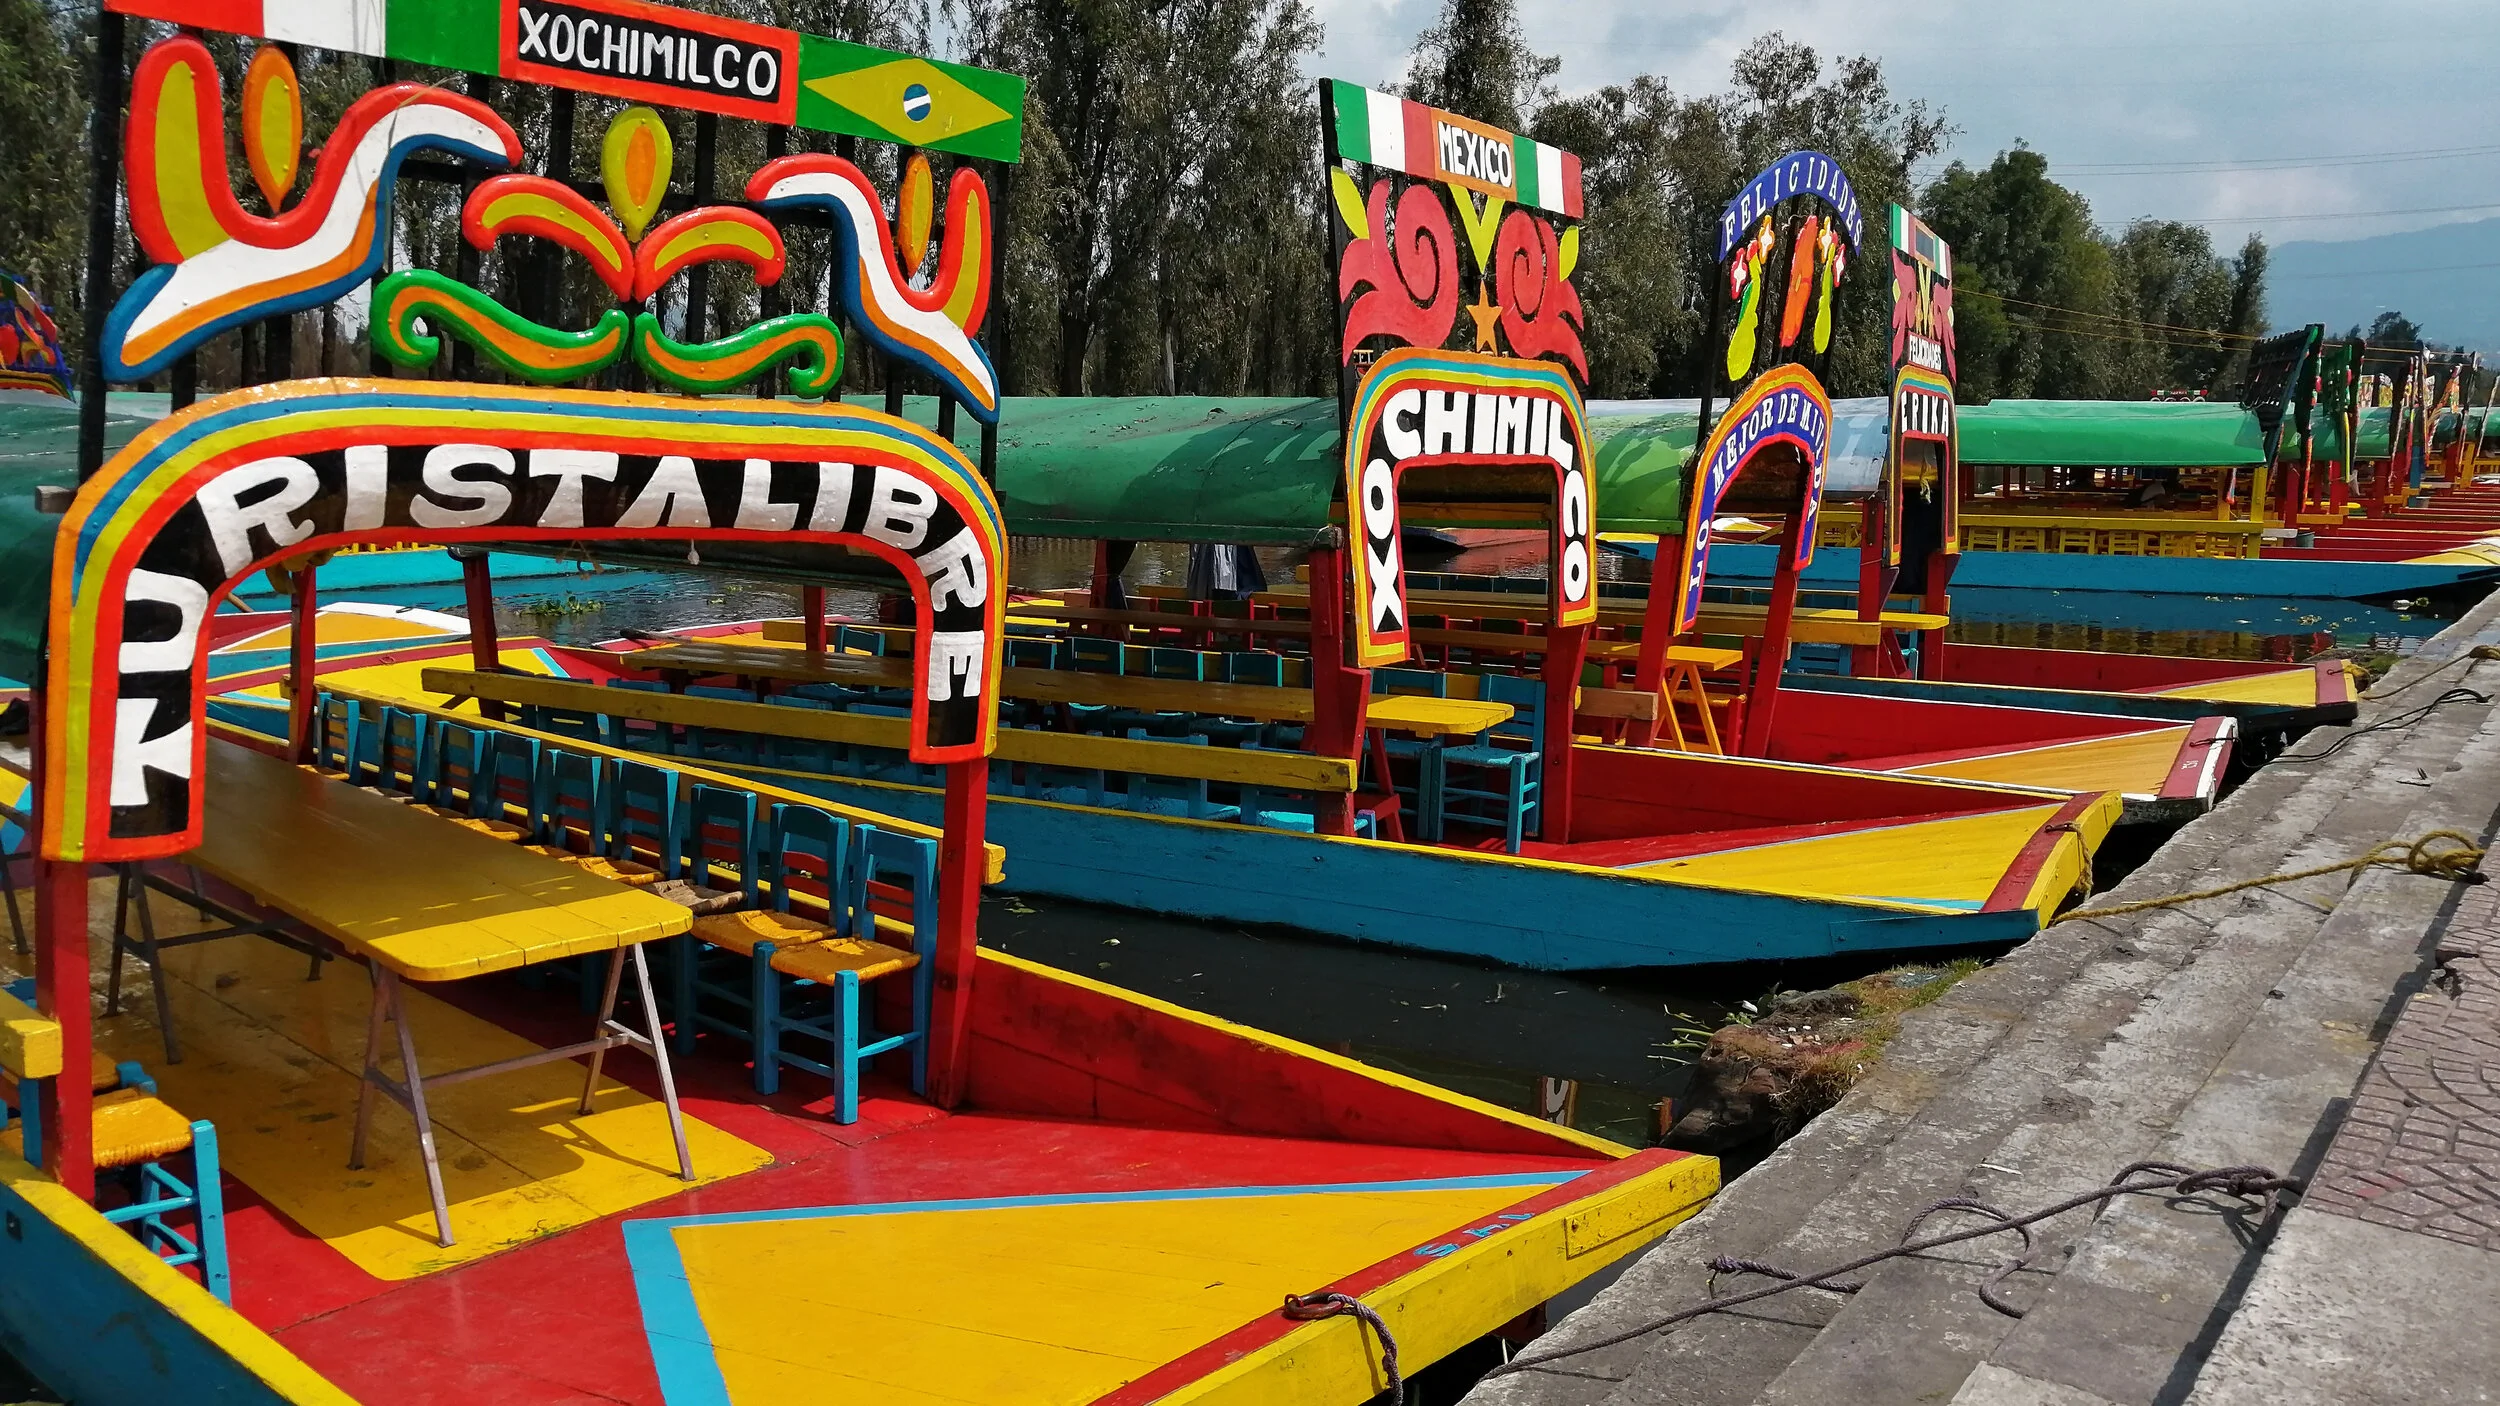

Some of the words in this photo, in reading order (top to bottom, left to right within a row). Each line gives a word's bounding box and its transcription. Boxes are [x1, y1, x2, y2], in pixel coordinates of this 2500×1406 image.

[519, 7, 778, 97] XOCHIMILCO
[1438, 121, 1512, 188] MEXICO
[1725, 156, 1863, 252] FELICIDADES
[1909, 334, 1941, 371] FELICIDADES
[1901, 391, 1949, 438] ERIKA
[1364, 388, 1588, 632] XOCHIMILCO
[1689, 518, 1710, 592] LO
[1713, 397, 1773, 496] MEJOR
[1777, 393, 1799, 424] DE
